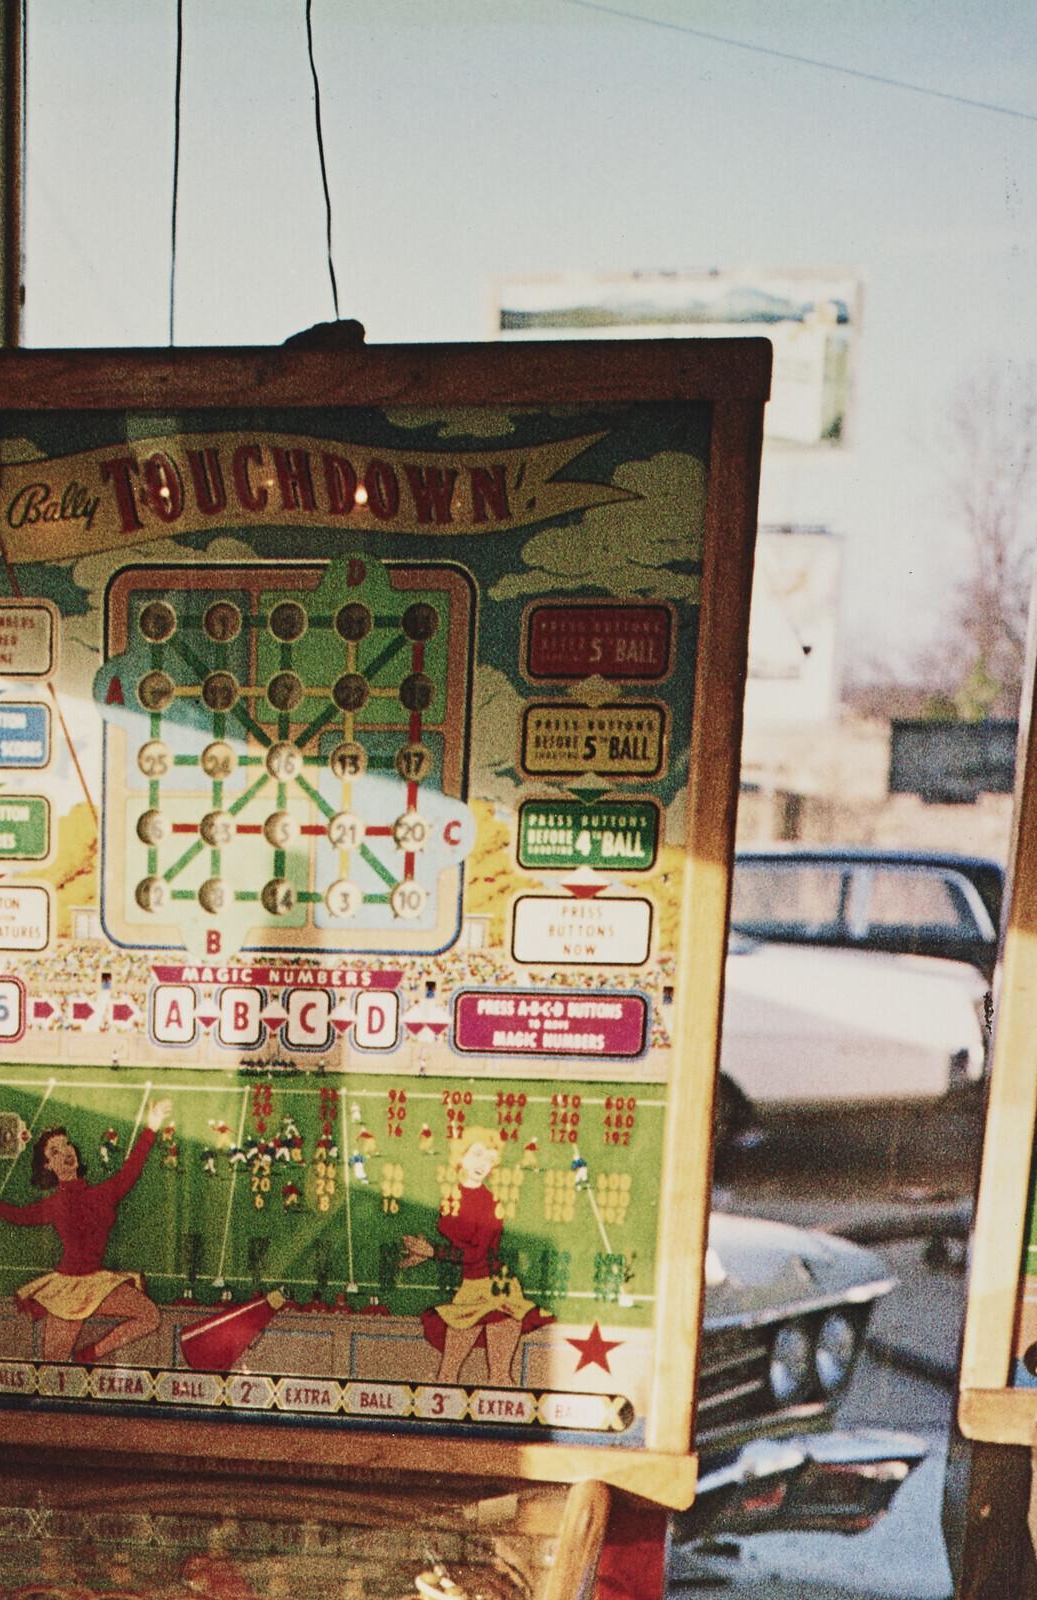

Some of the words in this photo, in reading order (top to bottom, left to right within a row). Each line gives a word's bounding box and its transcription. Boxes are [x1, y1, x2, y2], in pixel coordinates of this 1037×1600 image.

[6, 480, 99, 530] Bally
[99, 444, 536, 534] TOUCHDOWN!
[616, 638, 658, 663] BALL
[106, 676, 124, 706] A
[535, 719, 579, 731] PRESS
[588, 719, 654, 732] BUTTONS
[609, 736, 651, 761] BALL
[145, 755, 169, 775] 25
[208, 755, 232, 774] 24
[402, 752, 424, 775] 17
[528, 814, 574, 827] PRESS
[581, 815, 647, 828] BUTTONS
[335, 823, 357, 845] 21
[400, 821, 426, 843] 20
[444, 820, 461, 846] C
[526, 829, 575, 845] BEFORE
[601, 830, 645, 858] BALL
[339, 891, 352, 913] 3
[397, 890, 422, 911] 10
[561, 905, 603, 919] PRESS
[205, 930, 222, 954] B
[548, 924, 615, 938] BUTTONS
[563, 944, 596, 956] NOW
[180, 966, 253, 982] MAGIC
[269, 968, 372, 986] NUMBERS
[165, 1000, 183, 1029] A
[234, 1002, 249, 1031] B
[300, 1003, 317, 1033] C
[367, 1005, 385, 1036] D
[478, 999, 514, 1015] PRESS
[493, 1031, 537, 1047] MAGIC
[441, 1089, 473, 1105] 200
[386, 1106, 407, 1121] 50
[447, 1108, 466, 1123] 96
[251, 1177, 272, 1194] 20
[254, 1194, 265, 1211] 6
[318, 1195, 331, 1213] 8
[383, 1198, 400, 1215] 16
[98, 1376, 144, 1395] EXTRA
[171, 1381, 206, 1399] BALL
[284, 1385, 332, 1408] EXTRA
[359, 1393, 394, 1410] BALL
[477, 1398, 525, 1418] EXTRA
